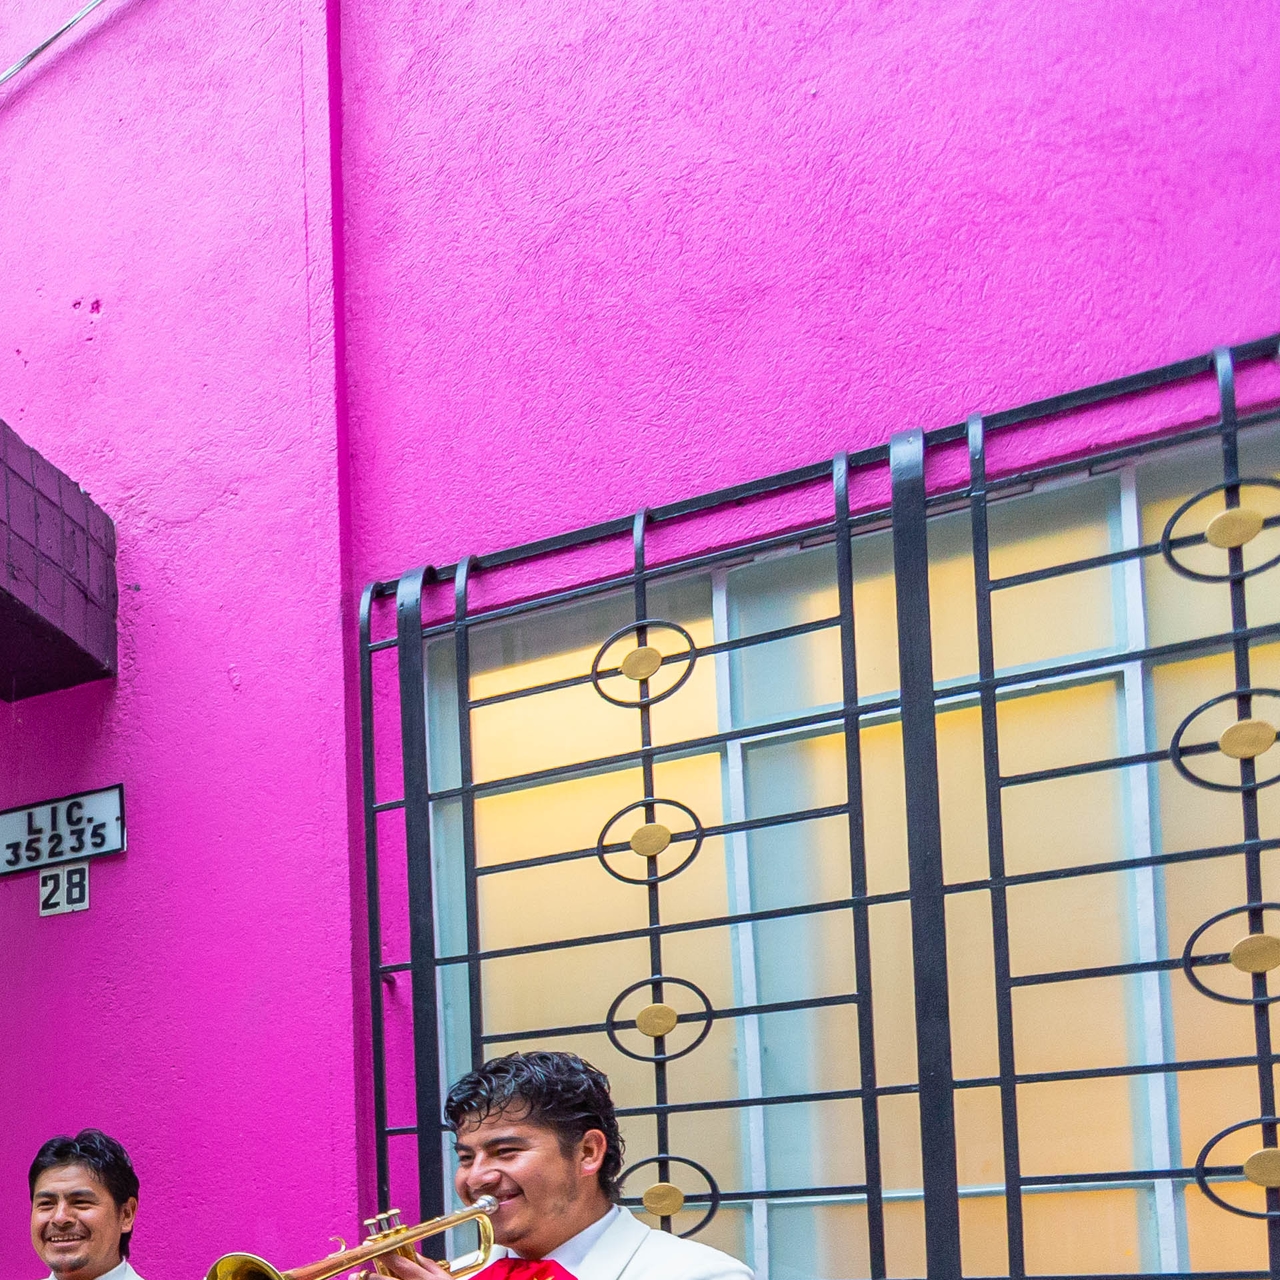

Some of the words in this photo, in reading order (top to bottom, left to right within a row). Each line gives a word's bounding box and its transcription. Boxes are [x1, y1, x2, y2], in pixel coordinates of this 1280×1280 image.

[26, 800, 94, 837] LIC.
[5, 822, 107, 867] 35235
[41, 867, 86, 911] 28
